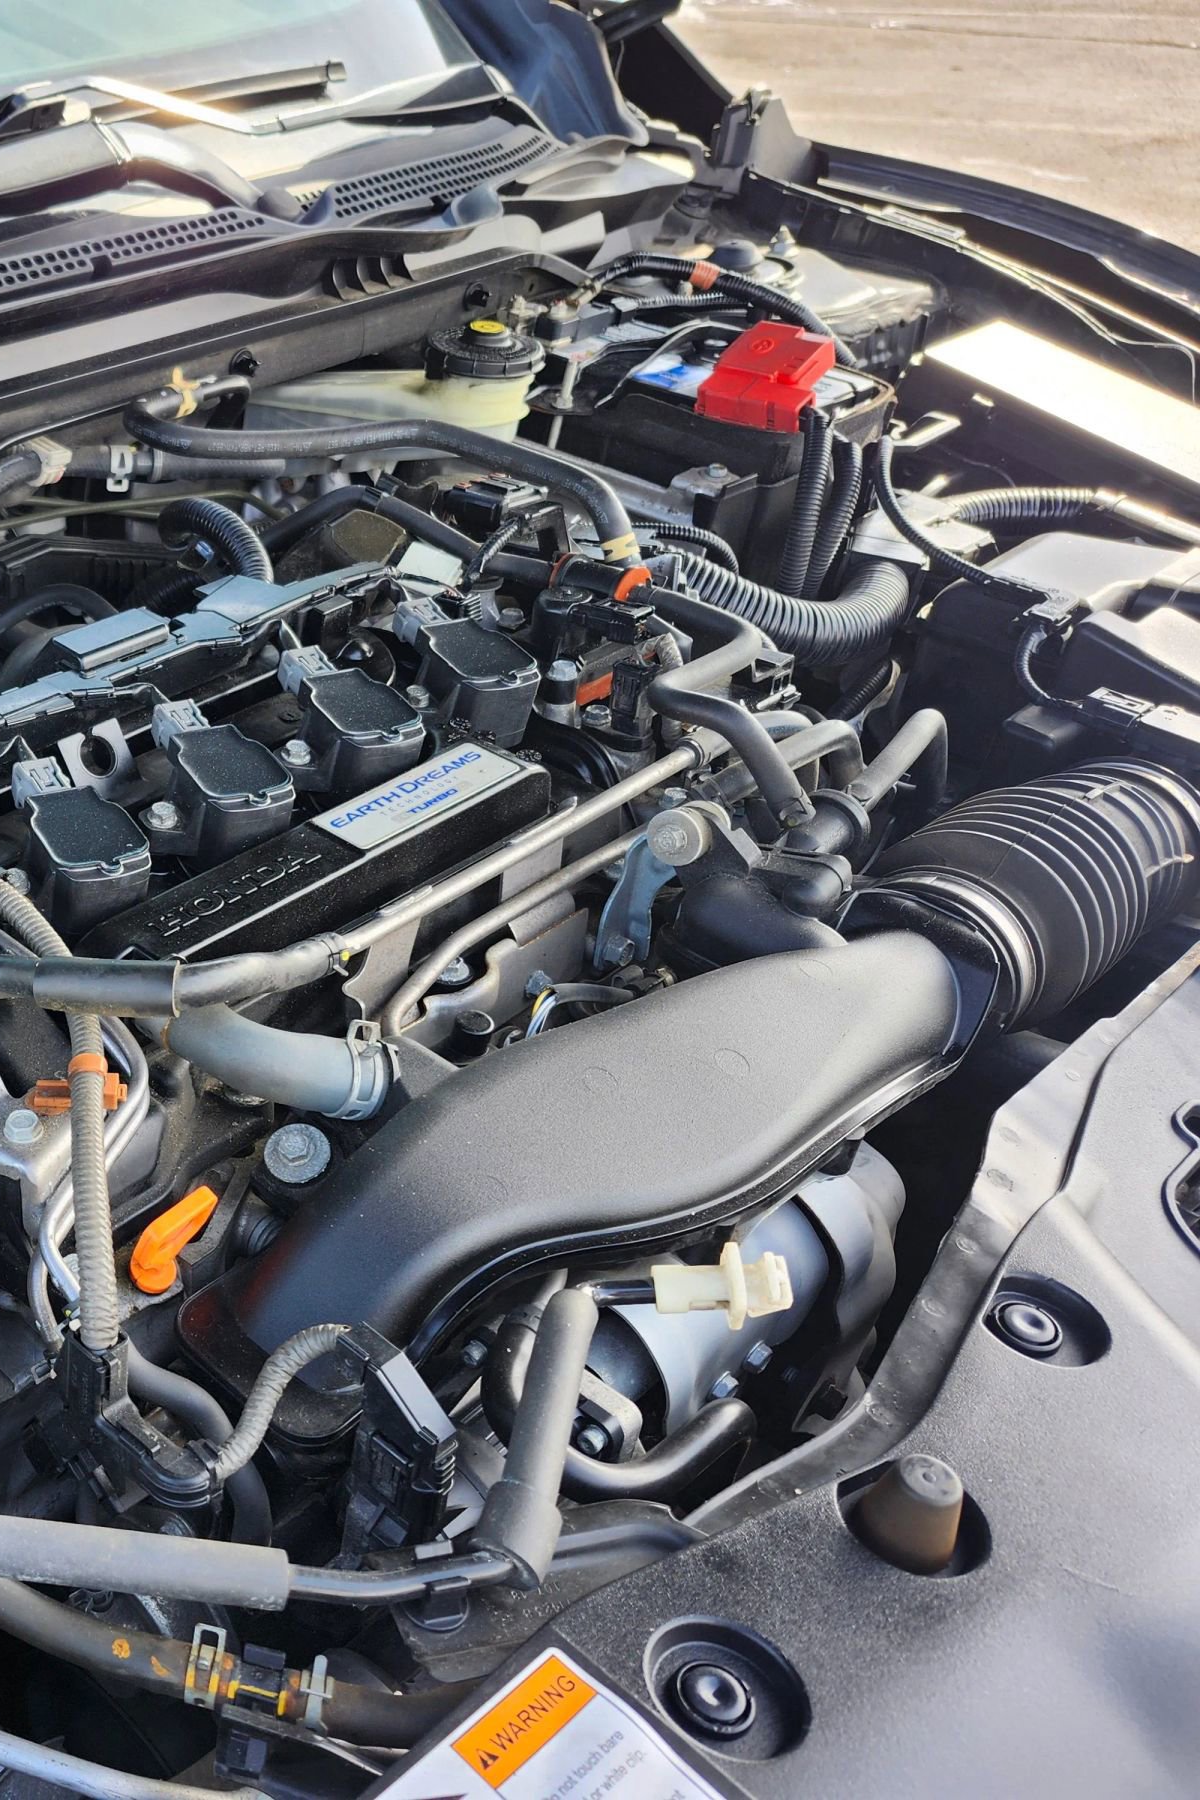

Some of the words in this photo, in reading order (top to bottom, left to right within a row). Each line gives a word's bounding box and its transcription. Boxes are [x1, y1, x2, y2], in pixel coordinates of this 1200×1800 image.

[330, 792, 401, 829] EARTH
[396, 751, 481, 794] DREAMS
[379, 775, 458, 816] TECHNOLOGY
[406, 788, 458, 814] TURBO
[147, 853, 322, 937] HONDA
[490, 1674, 576, 1751] WARNING
[558, 1775, 579, 1797] not
[573, 1747, 605, 1779] touch
[600, 1730, 625, 1754] bare
[601, 1764, 629, 1791] white
